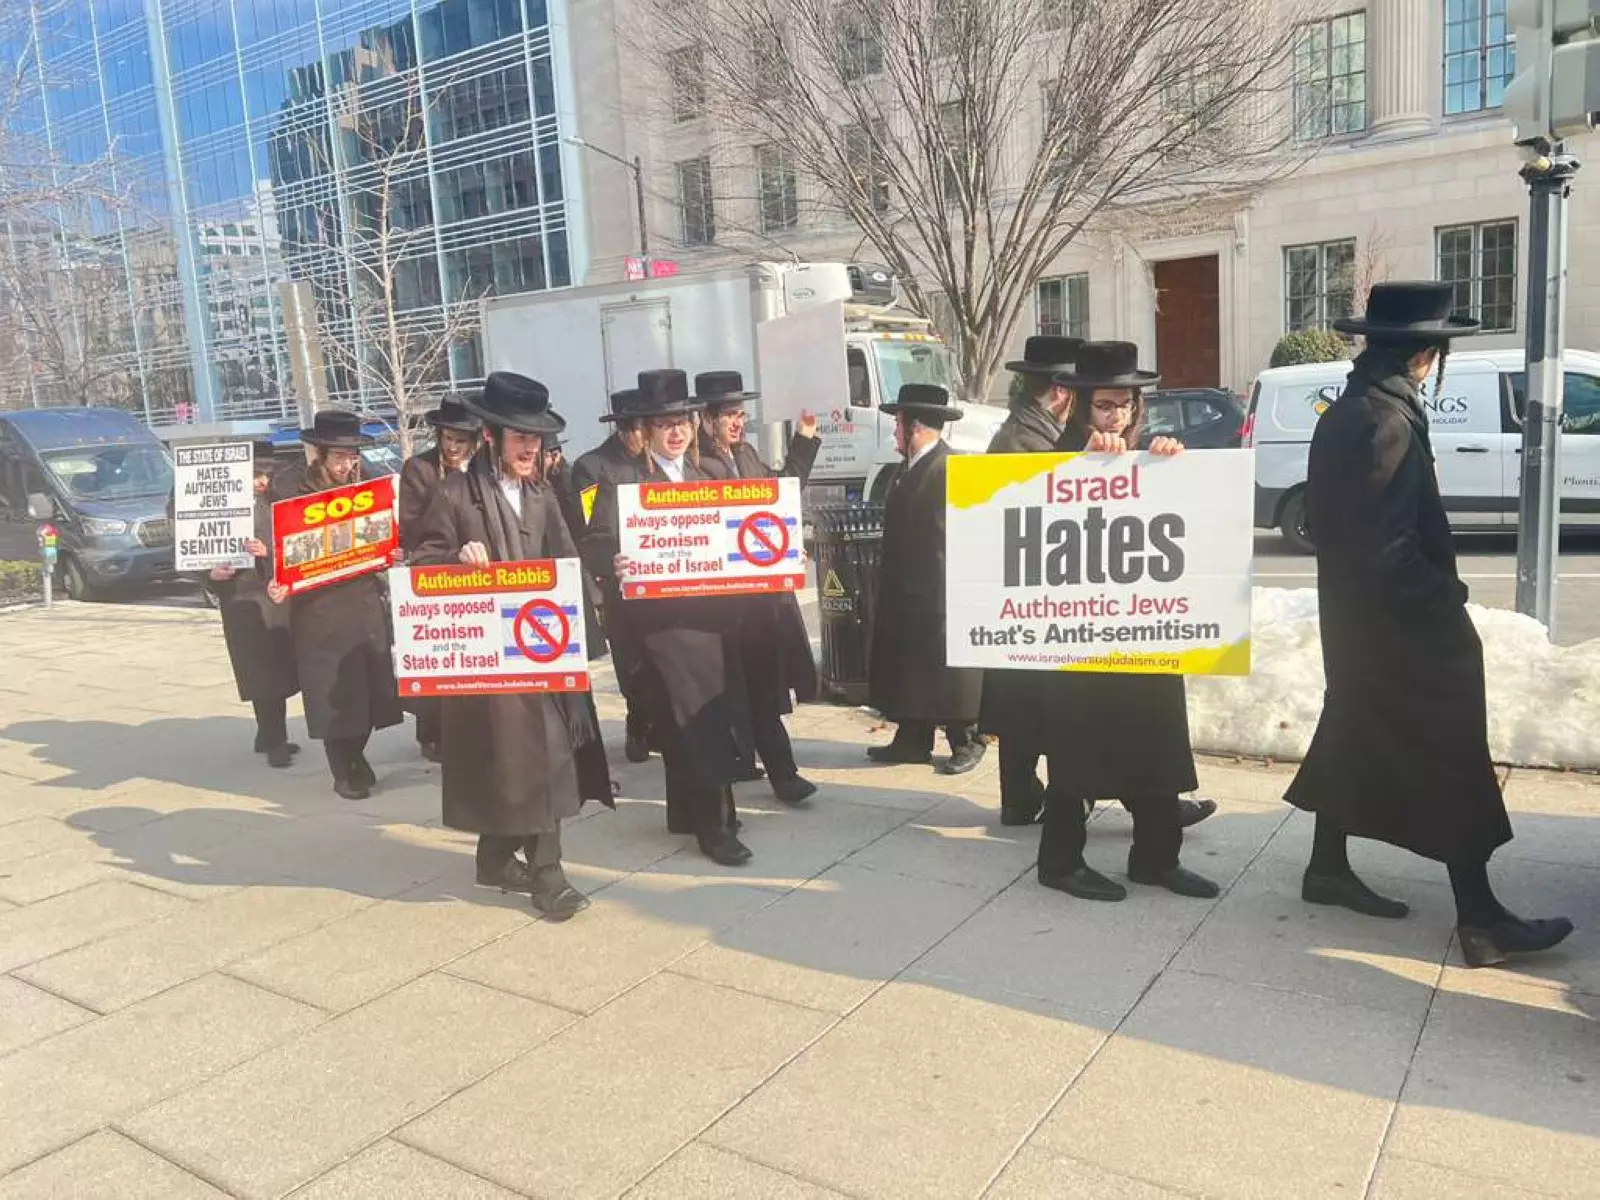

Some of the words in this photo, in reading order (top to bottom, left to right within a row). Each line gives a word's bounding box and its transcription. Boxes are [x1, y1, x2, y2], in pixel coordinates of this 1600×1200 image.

[178, 449, 192, 464] THE
[214, 446, 223, 462] OF
[197, 466, 229, 481] HATES
[185, 479, 243, 496] AUTHENTIC
[1046, 464, 1140, 504] Israel
[199, 494, 228, 508] JEWS
[646, 486, 718, 504] Authentic
[723, 485, 773, 501] Rabbis
[303, 490, 375, 525] SOS
[198, 521, 231, 537] ANTI
[626, 512, 668, 531] always
[670, 510, 721, 529] opposed
[639, 533, 709, 550] Zionism
[1003, 506, 1186, 587] Hates
[677, 549, 692, 558] the
[628, 560, 665, 576] State
[668, 560, 681, 575] of
[685, 557, 724, 573] Israel
[417, 569, 492, 590] Authentic
[496, 567, 551, 586] Rabbis
[398, 600, 440, 620] always
[443, 597, 495, 619] opposed
[999, 594, 1120, 620] Authentic
[1127, 594, 1189, 616] Jews
[412, 624, 484, 641] Zionism
[969, 625, 1036, 646] that's
[1043, 621, 1220, 645] Anti-semitism
[431, 642, 449, 652] and
[451, 641, 467, 652] the
[402, 653, 439, 671] State
[442, 653, 456, 670] of
[460, 651, 500, 669] Israel
[1007, 652, 1180, 669] www.israelversusjudaism.org
